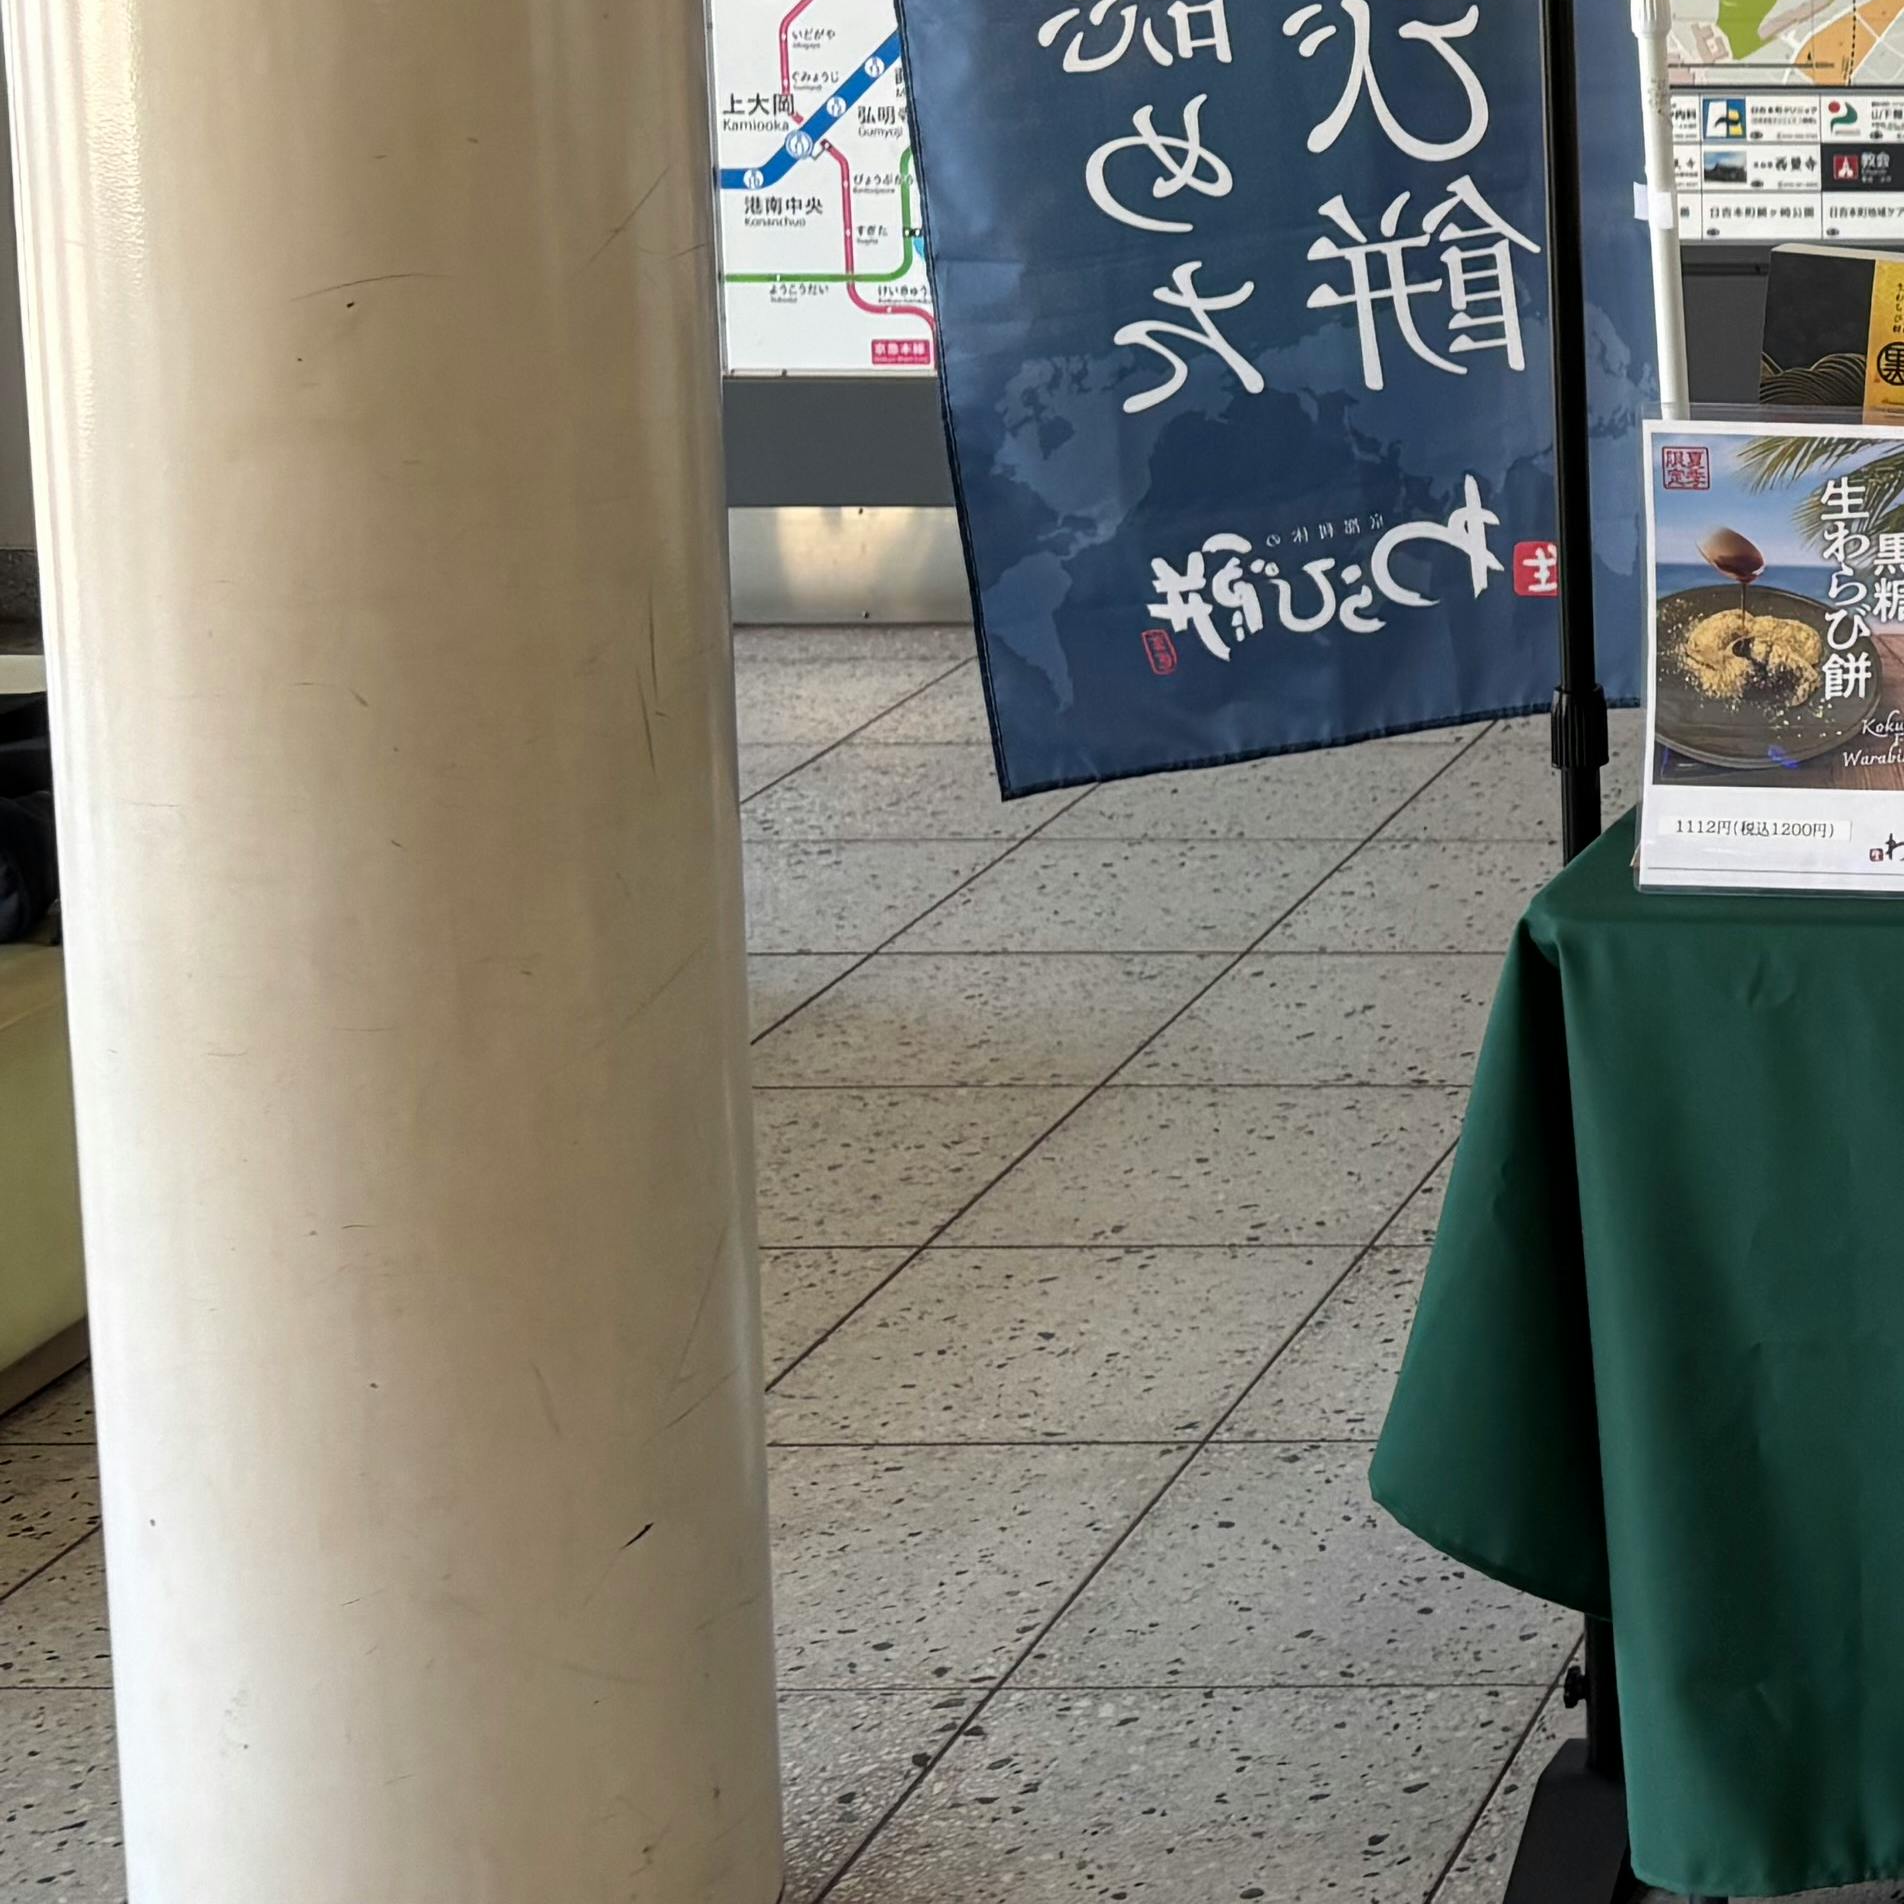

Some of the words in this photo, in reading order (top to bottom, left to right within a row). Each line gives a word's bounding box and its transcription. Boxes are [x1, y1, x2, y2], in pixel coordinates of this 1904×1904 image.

[723, 94, 794, 116] 上大岡
[1821, 476, 1871, 700] 生わらび餅
[1675, 819, 1834, 839] 1112円(税込1200円)
